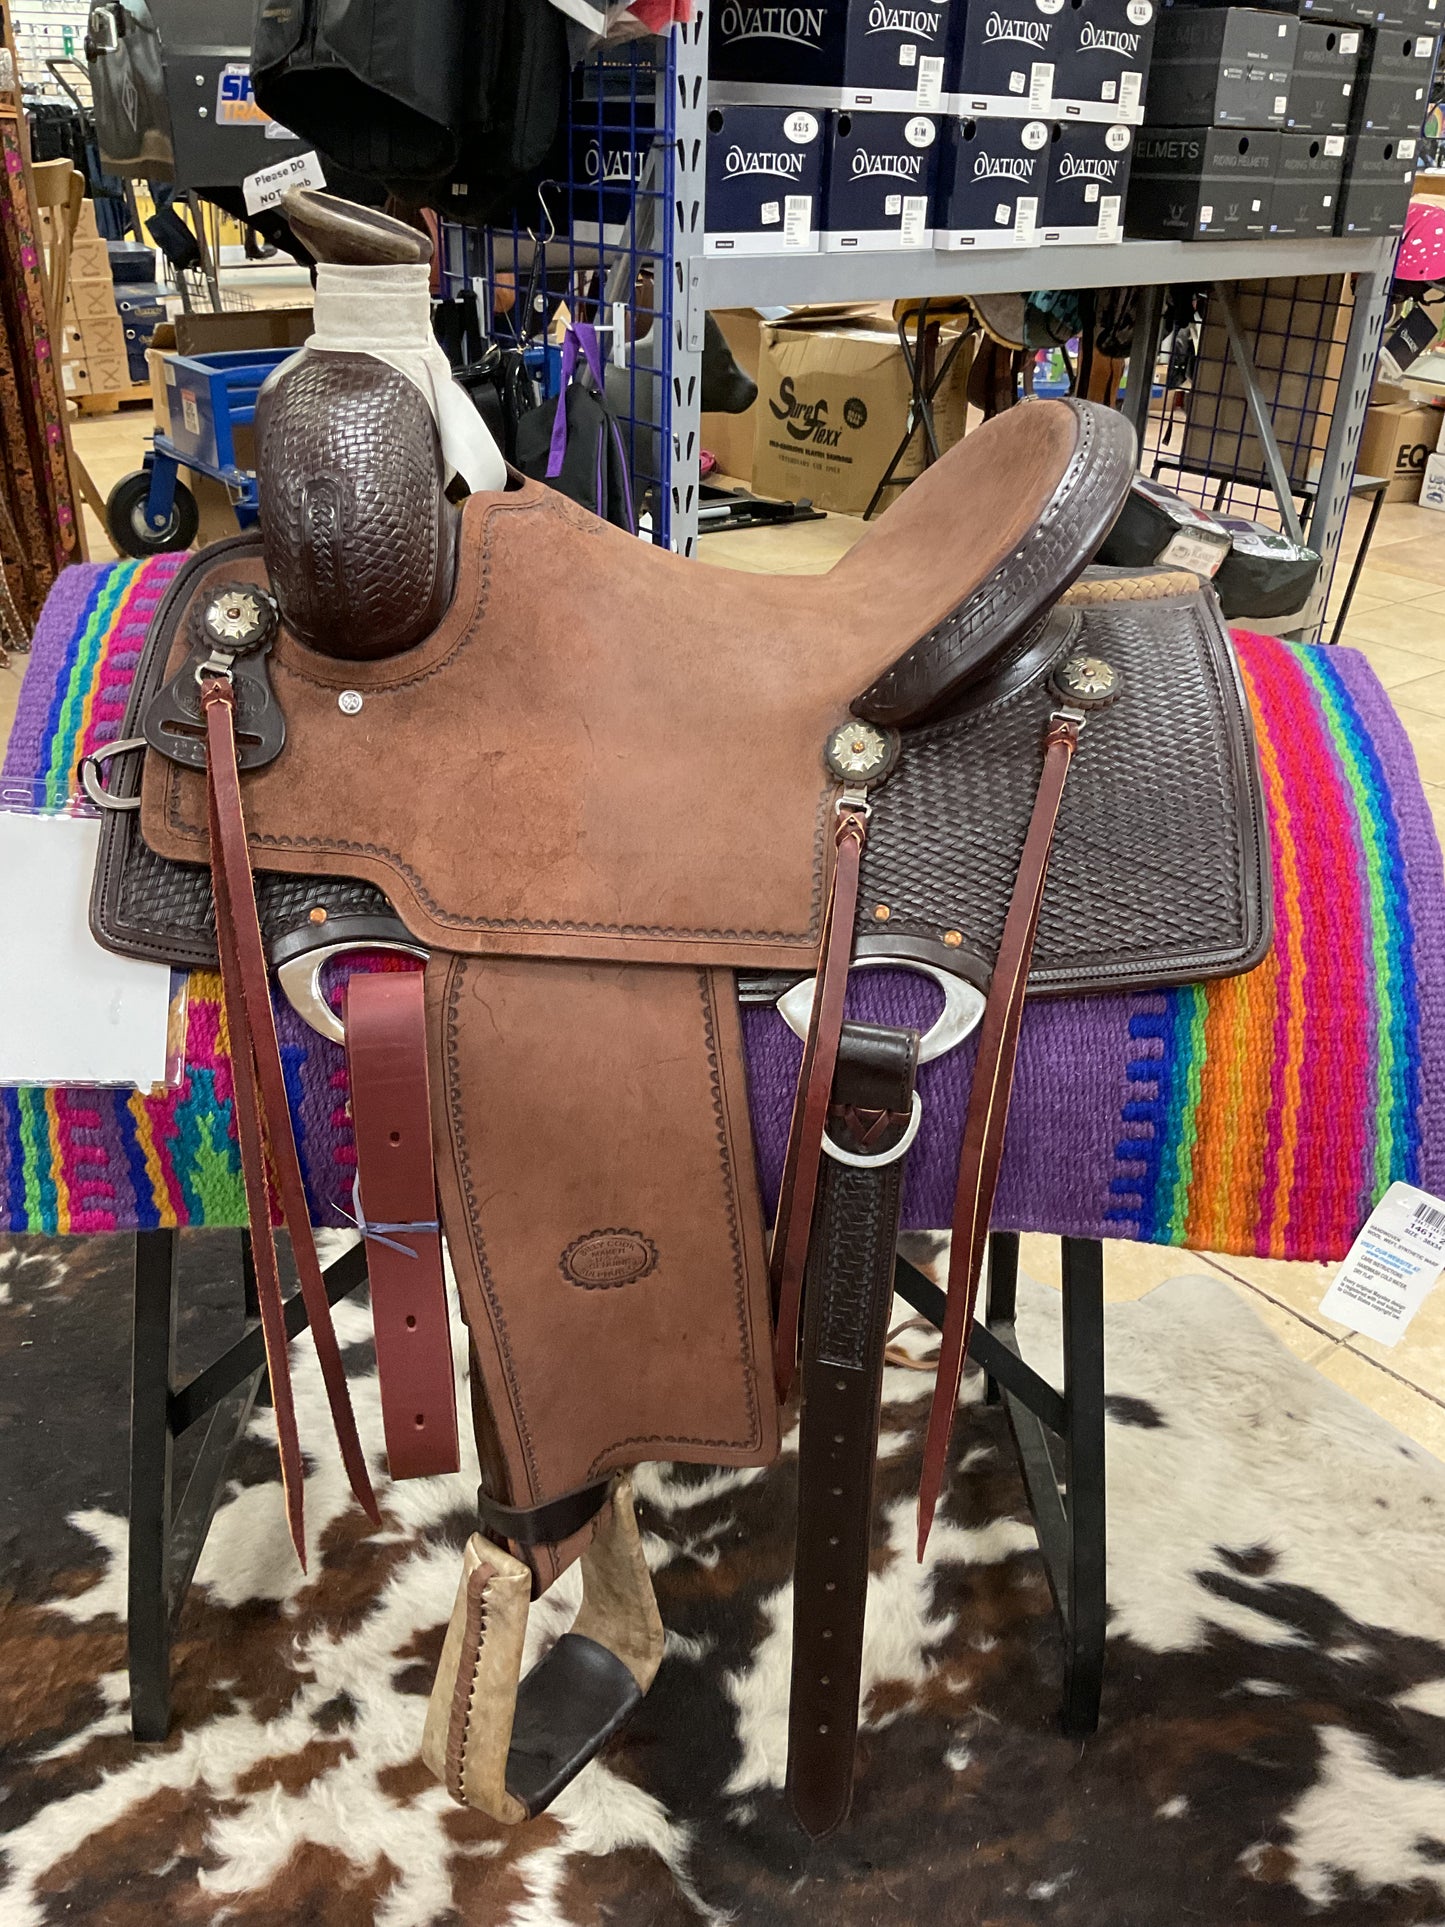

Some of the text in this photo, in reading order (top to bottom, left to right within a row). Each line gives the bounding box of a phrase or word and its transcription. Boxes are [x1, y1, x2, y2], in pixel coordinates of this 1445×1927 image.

[721, 0, 825, 36] OVATION
[868, 0, 940, 32] OVATION
[985, 11, 1050, 41] OVATION
[1080, 21, 1140, 51] OVATION
[793, 122, 809, 132] XS/S
[914, 127, 927, 137] S/M
[585, 139, 645, 181] OVATI
[725, 145, 804, 172] OVATION
[852, 148, 922, 174] OVATION
[974, 151, 1034, 176] OVATION
[1059, 152, 1118, 176] OVATION
[254, 160, 305, 186] Please DO
[260, 189, 283, 204] NOT
[1370, 1225, 1400, 1241] HANDWOVEN
[1404, 1229, 1417, 1237] SIZE
[1360, 1240, 1375, 1250] VISIT
[1374, 1247, 1387, 1256] OUR
[1387, 1253, 1412, 1268] WEBSITE
[1360, 1255, 1372, 1263] CARE
[1356, 1262, 1380, 1275] HANDWASH
[1380, 1274, 1392, 1282] COLD
[1362, 1272, 1373, 1280] FLAT
[1343, 1276, 1356, 1286] Every
[1355, 1283, 1372, 1294] original
[1342, 1290, 1356, 1298] United
[1357, 1297, 1370, 1305] States
[1370, 1303, 1391, 1315] copyright
[1344, 1284, 1366, 1297] registered
[1385, 1304, 1401, 1314] subject
